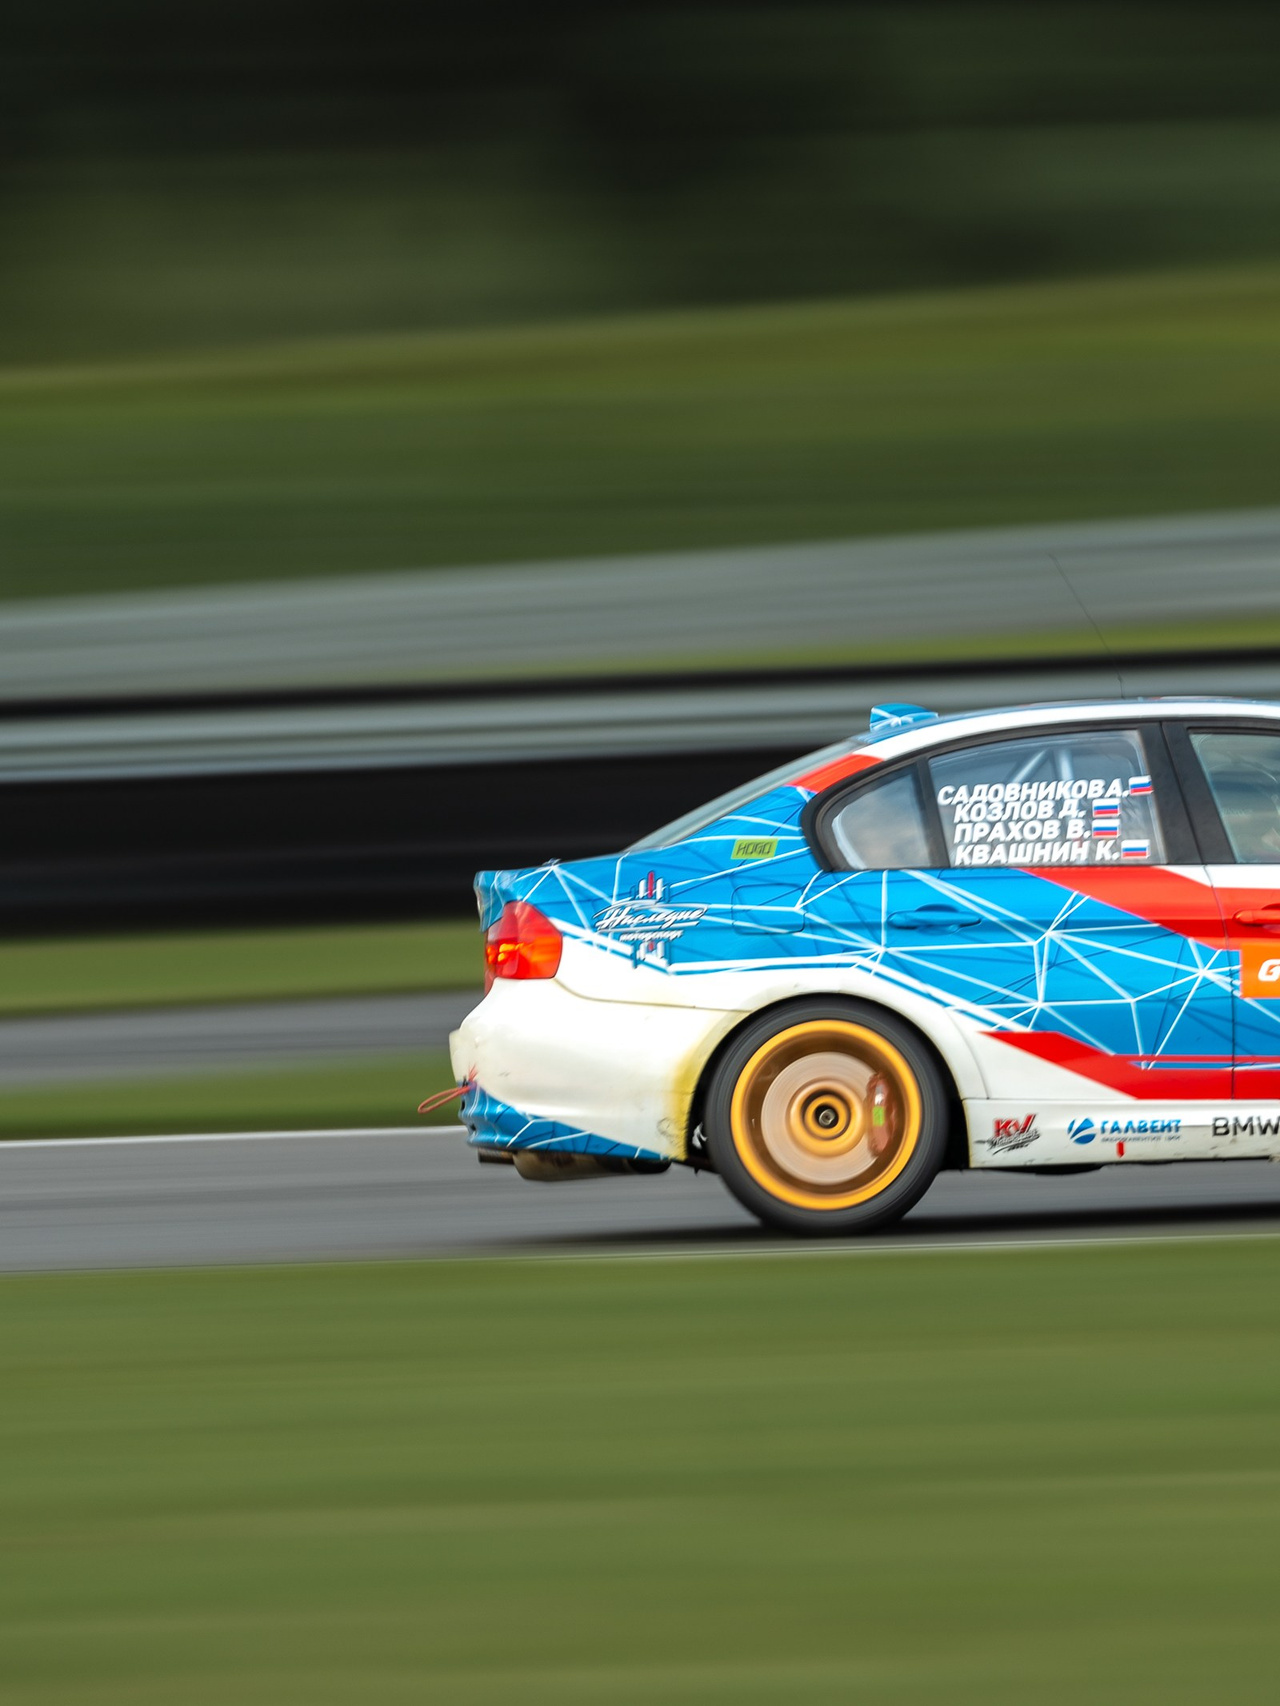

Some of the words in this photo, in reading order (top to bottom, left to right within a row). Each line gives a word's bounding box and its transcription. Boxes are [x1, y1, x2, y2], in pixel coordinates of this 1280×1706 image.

[953, 800, 1056, 824] КОЗЛОВ
[1058, 799, 1087, 819] Д.
[953, 821, 1061, 844] ПРАХОВ
[1066, 819, 1090, 840] В.
[954, 841, 1092, 866] КВАШНИН
[1095, 840, 1120, 861] К.
